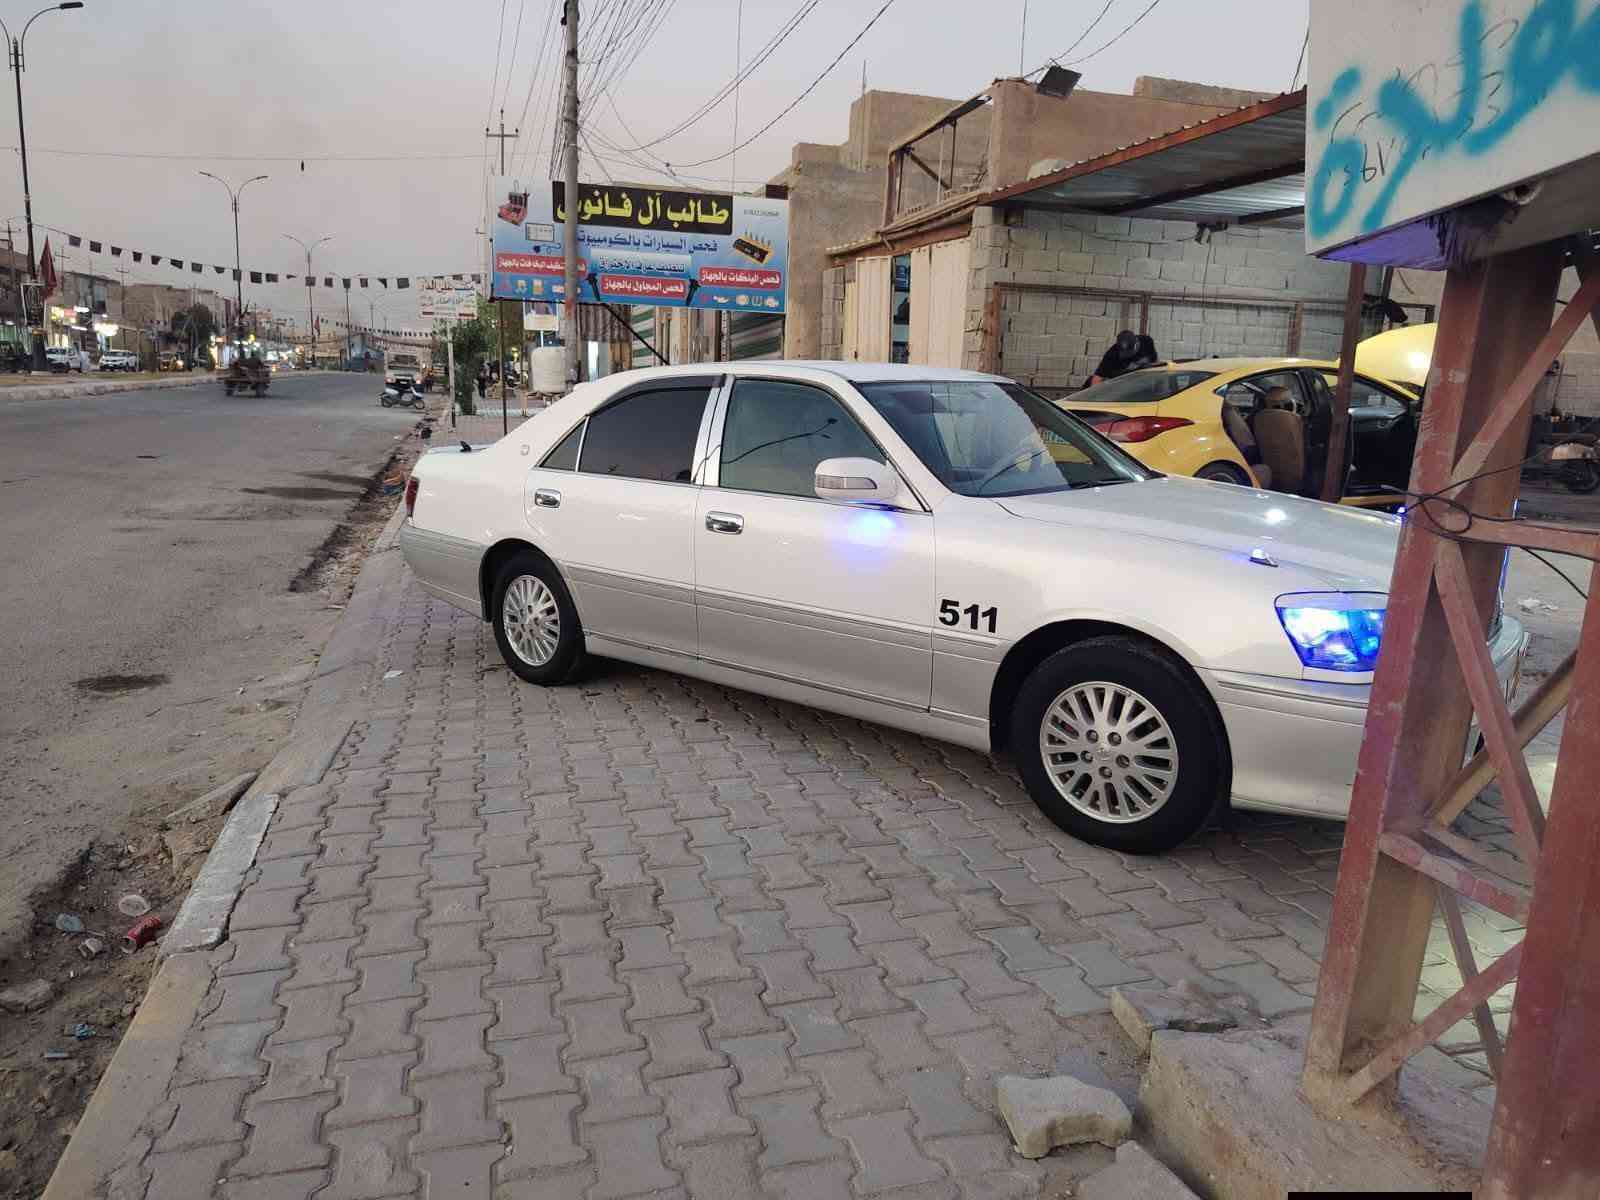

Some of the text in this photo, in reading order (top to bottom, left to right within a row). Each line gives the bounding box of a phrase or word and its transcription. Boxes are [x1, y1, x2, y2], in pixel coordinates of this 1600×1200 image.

[638, 192, 663, 225] آل
[667, 199, 729, 228] طالب
[577, 230, 719, 255] فحص السيارات بالكومبيوت
[603, 278, 631, 290] بالجهاز
[701, 270, 727, 282] بالجهاز
[759, 273, 780, 286] فحص
[662, 281, 684, 294] فحص
[938, 598, 999, 634] 511
